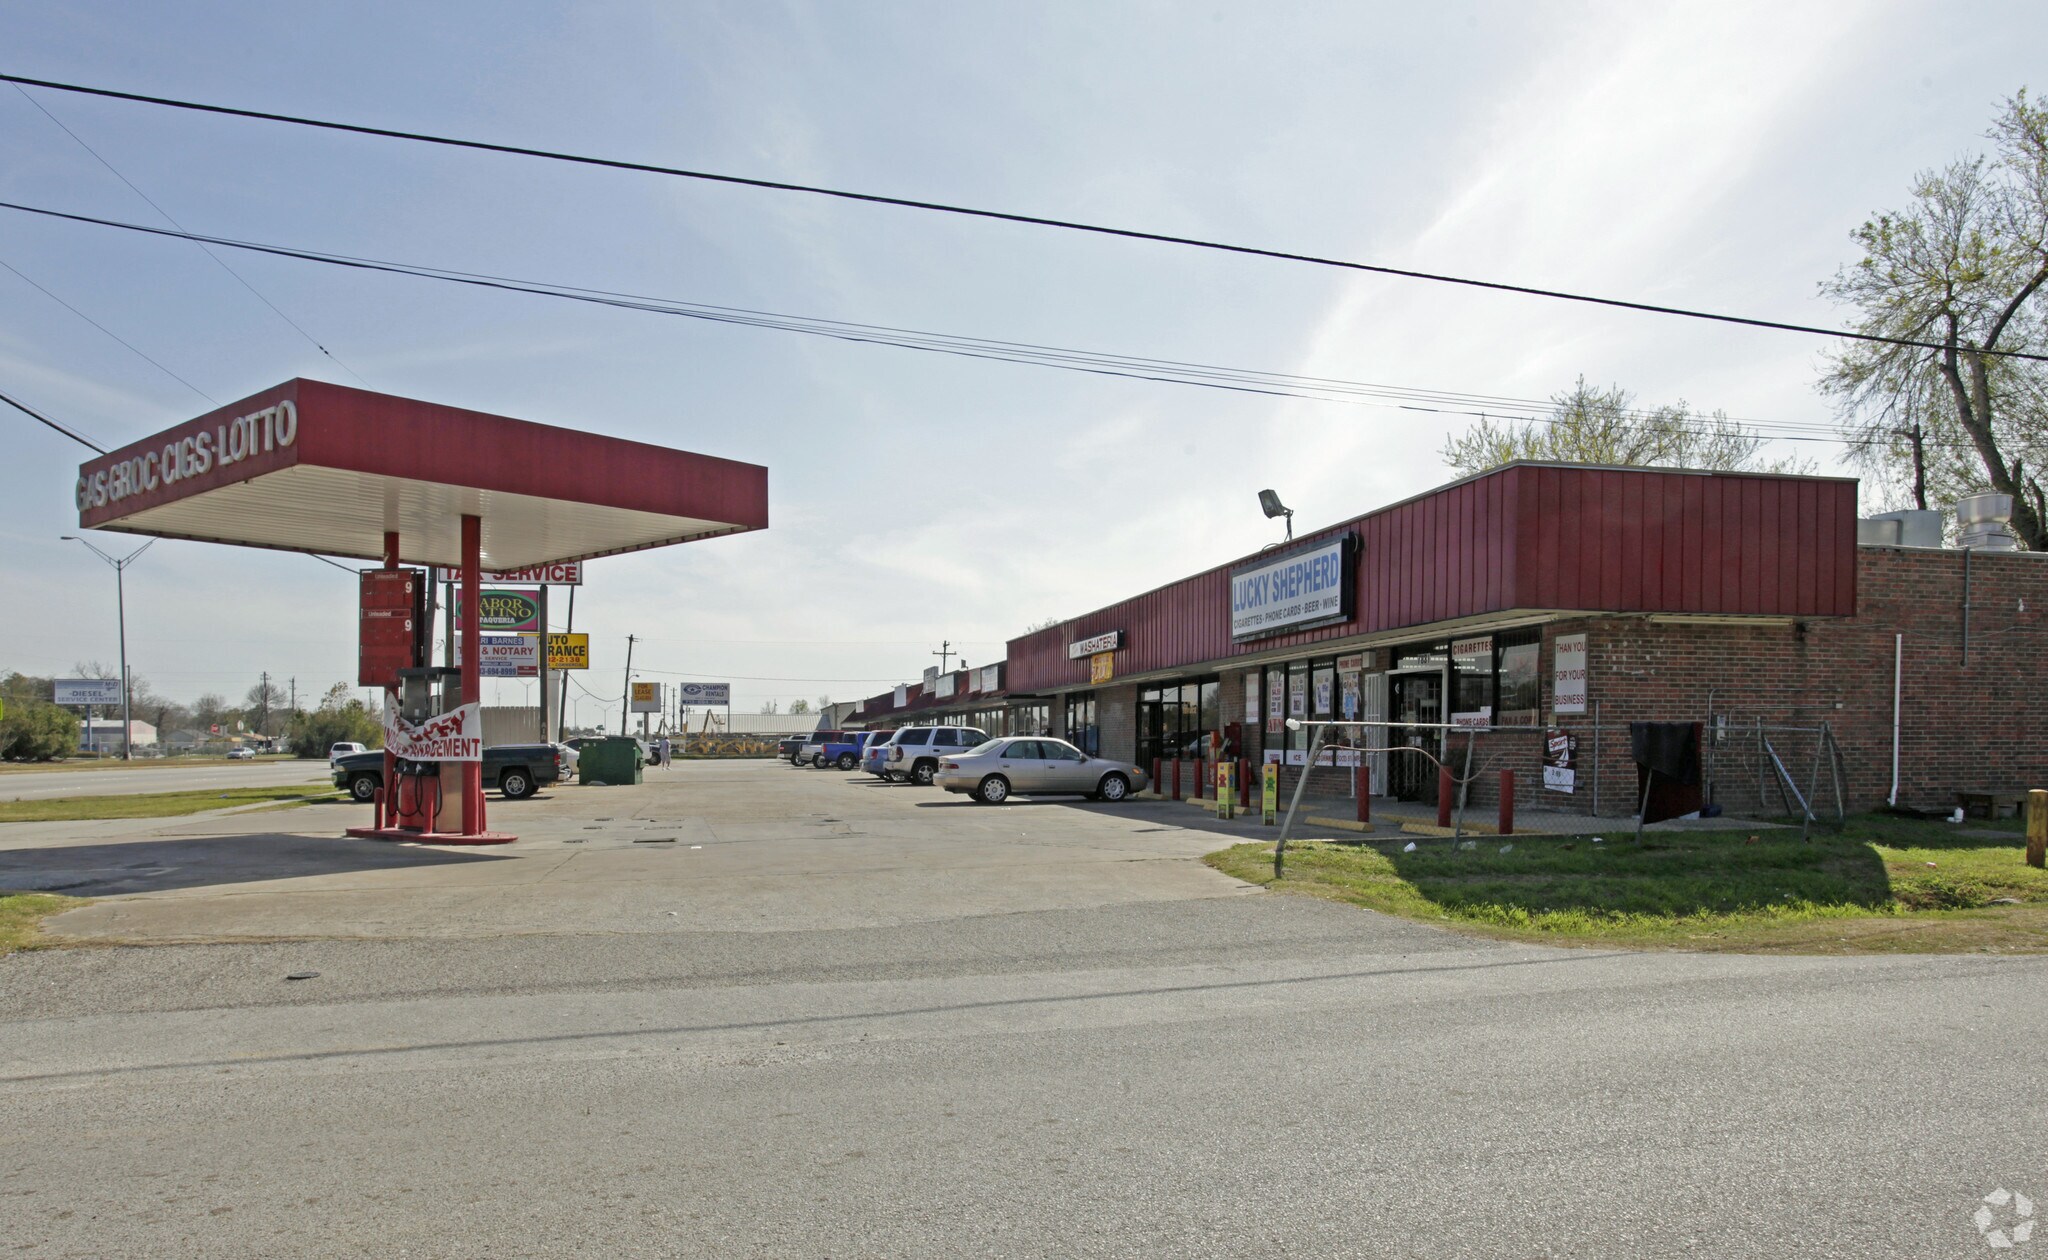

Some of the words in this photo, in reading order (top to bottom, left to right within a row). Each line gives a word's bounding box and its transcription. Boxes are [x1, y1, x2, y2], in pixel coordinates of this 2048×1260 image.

[162, 432, 212, 484] CIGS
[218, 400, 297, 466] LOTTO
[405, 581, 412, 593] 9
[1233, 573, 1269, 612] LUCKY
[1272, 552, 1339, 602] SHEPHERD
[480, 598, 522, 609] ABOR
[480, 608, 531, 618] ATINO
[1234, 614, 1262, 629] CIGARETTES
[1265, 609, 1282, 622] PHONE
[1283, 604, 1301, 618] CARDS
[1304, 600, 1319, 614] BEER
[1323, 595, 1338, 610] WINE
[404, 619, 412, 631] 9
[492, 637, 523, 645] BARNES
[548, 635, 568, 644] UTO
[493, 647, 534, 655] NOTARY
[1453, 640, 1493, 656] CIGARETTES
[1556, 642, 1572, 653] THAN
[1573, 641, 1585, 652] YOU
[1556, 670, 1567, 681] FOR
[1569, 669, 1585, 680] YOUR
[1555, 694, 1584, 705] BUSINESS
